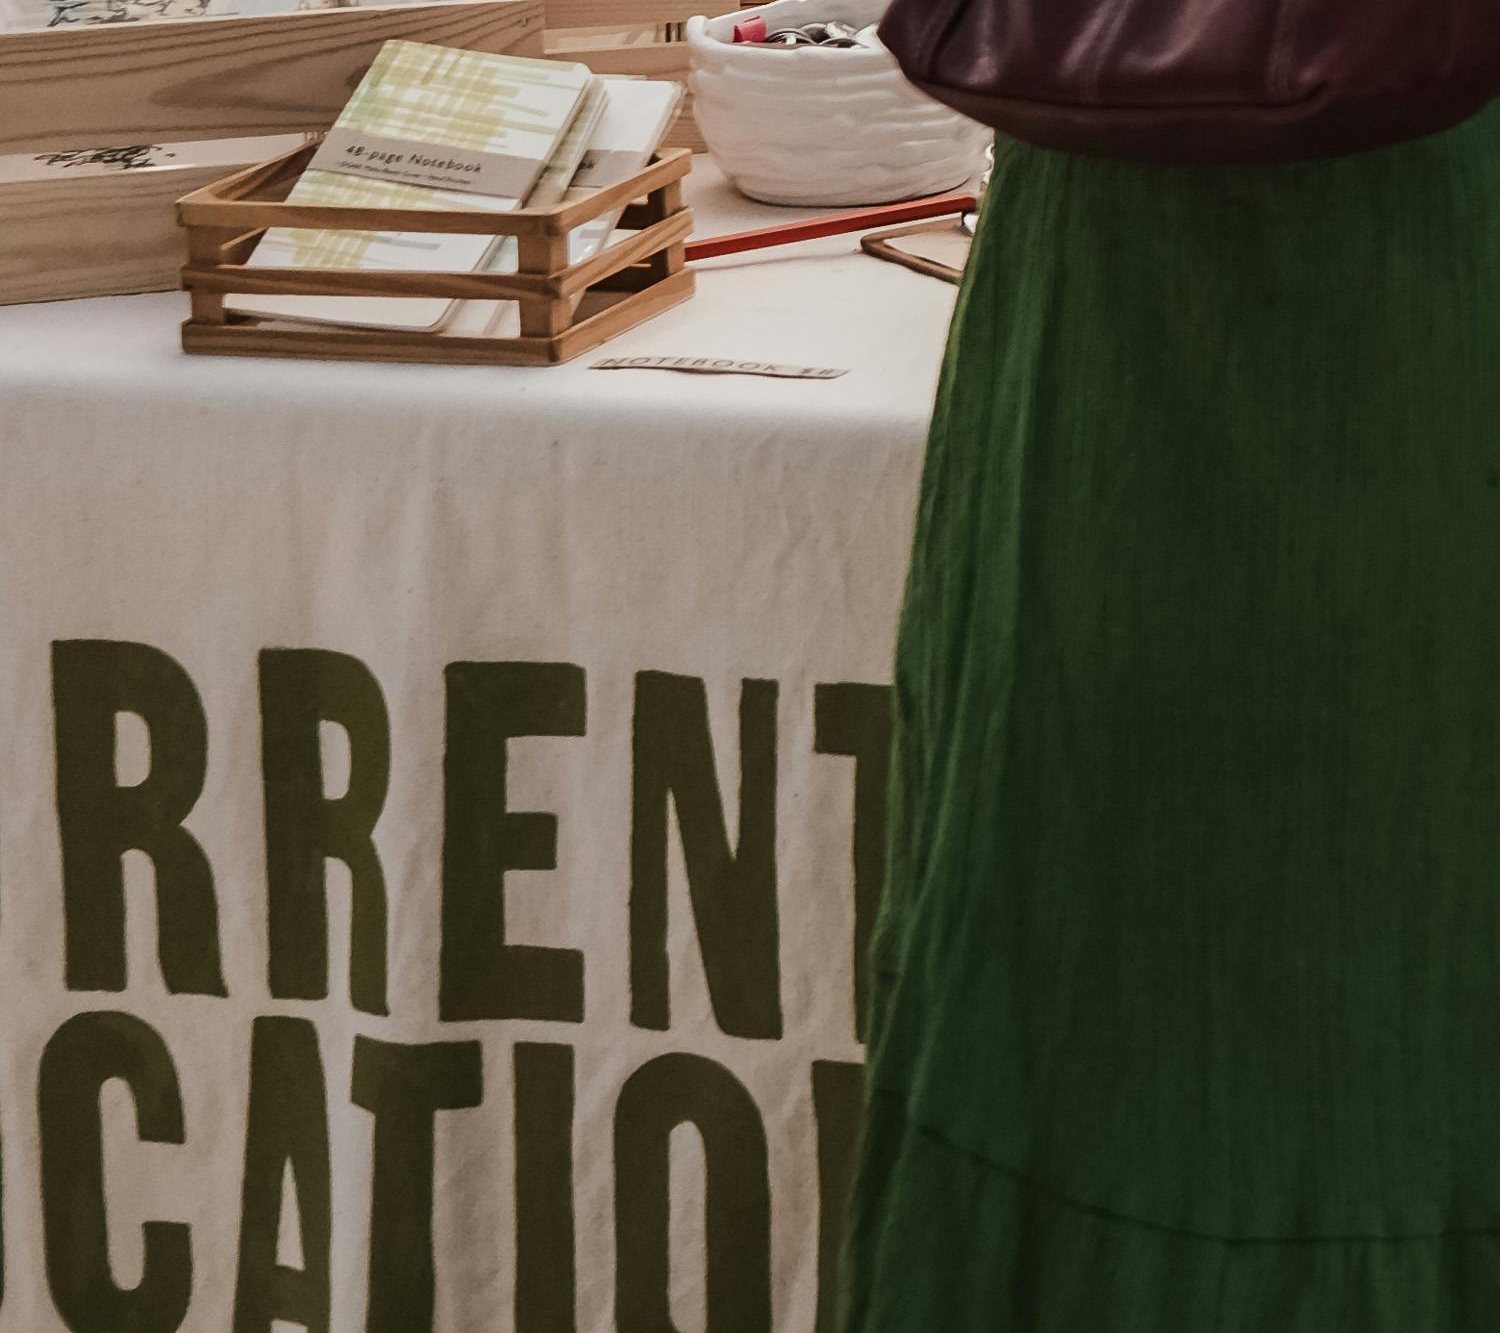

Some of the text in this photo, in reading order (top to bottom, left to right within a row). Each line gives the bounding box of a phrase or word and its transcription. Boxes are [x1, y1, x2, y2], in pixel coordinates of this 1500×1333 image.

[406, 152, 482, 174] Notebook
[600, 357, 778, 372] NOTEBOOK
[0, 1010, 868, 1333] CATIO
